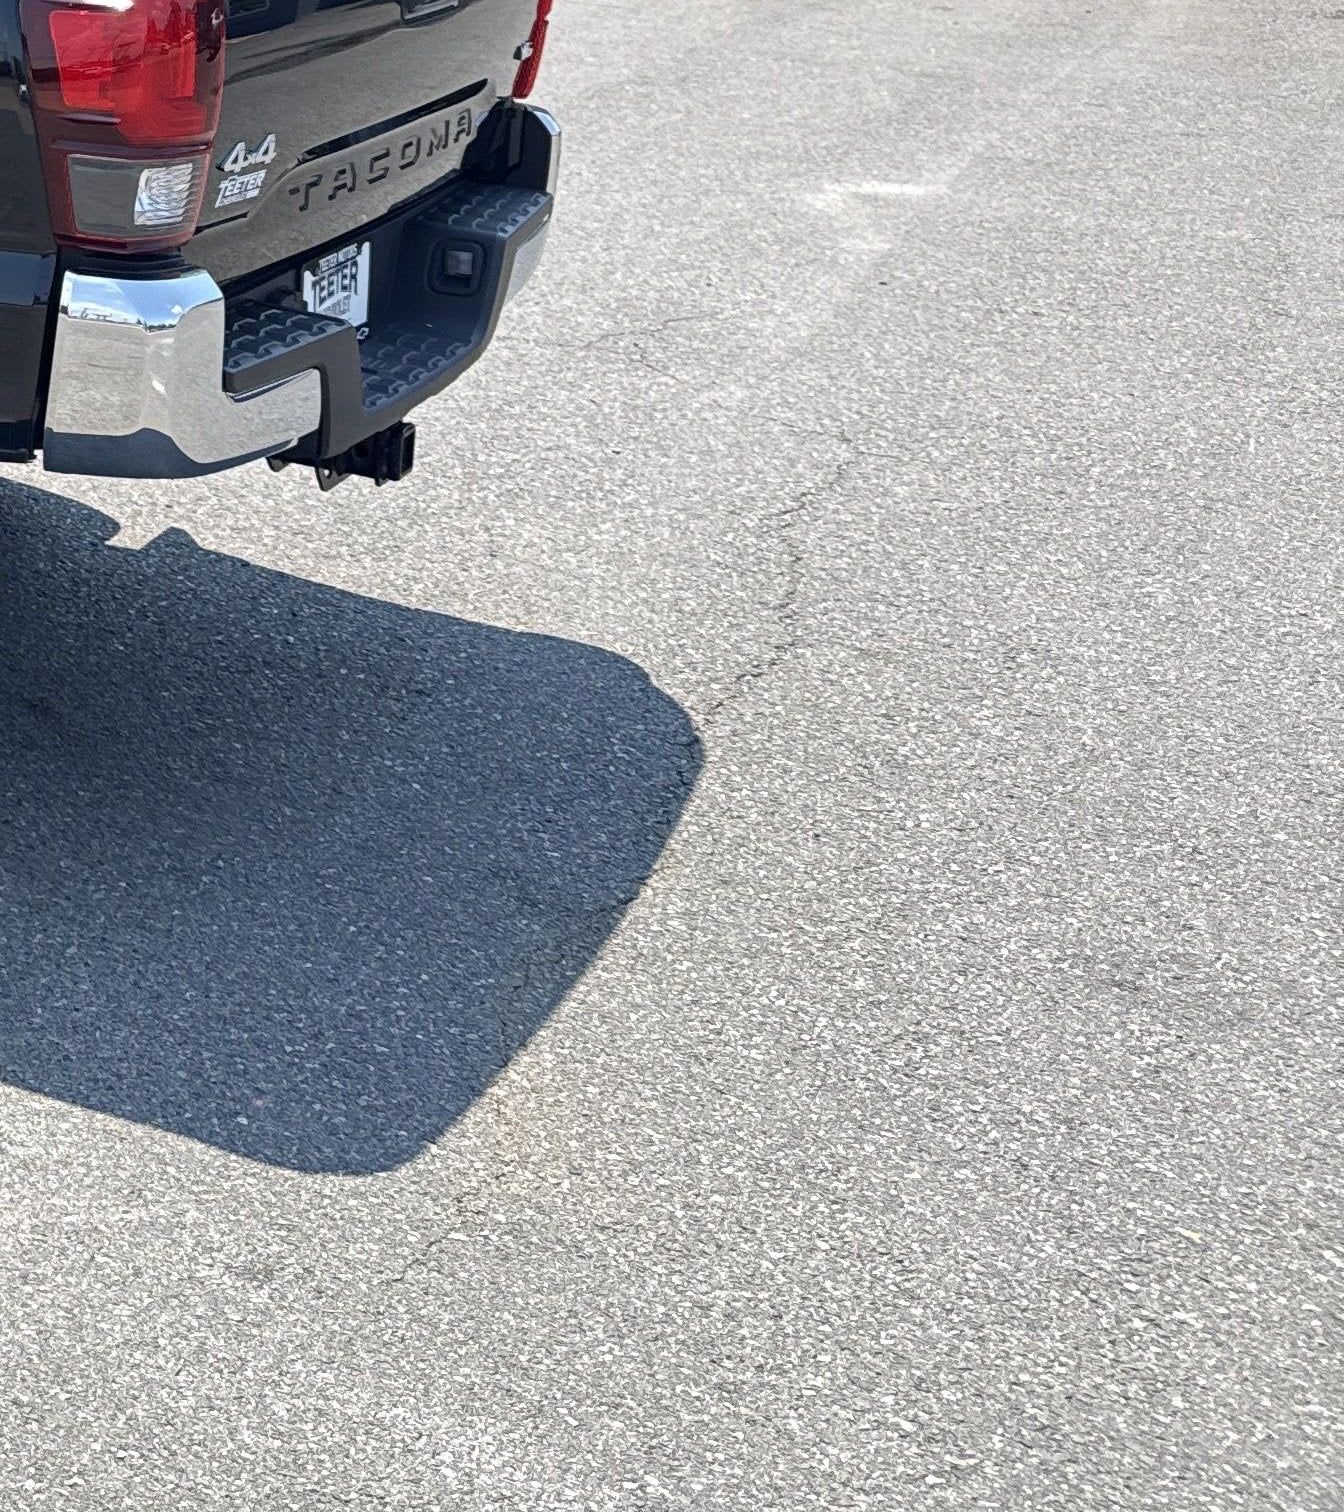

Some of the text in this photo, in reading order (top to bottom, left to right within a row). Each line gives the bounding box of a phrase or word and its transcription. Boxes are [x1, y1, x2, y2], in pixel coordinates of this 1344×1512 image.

[288, 108, 473, 212] TACOMA
[215, 169, 268, 204] TEETER
[312, 259, 359, 310] TEETER
